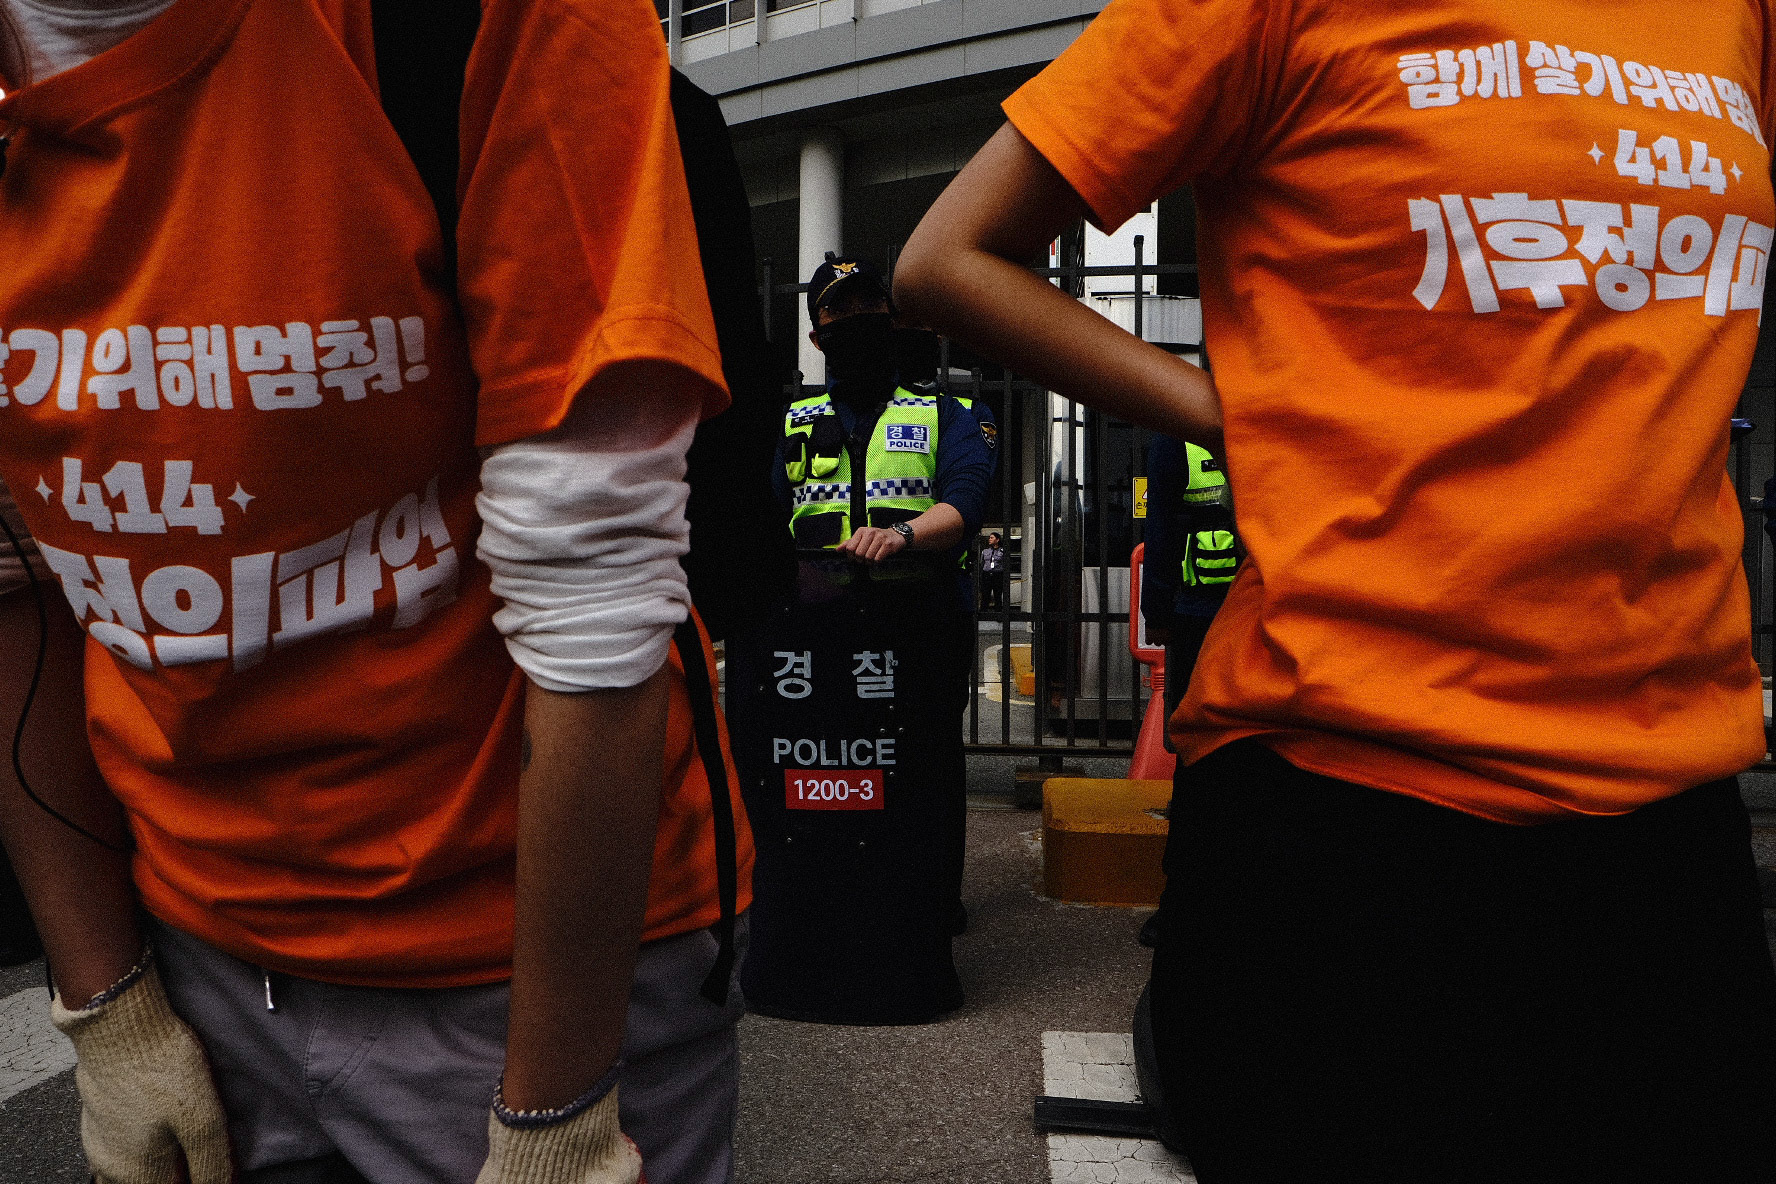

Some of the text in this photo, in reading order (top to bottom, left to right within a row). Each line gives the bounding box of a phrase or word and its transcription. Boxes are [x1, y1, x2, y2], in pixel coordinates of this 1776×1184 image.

[1397, 40, 1522, 110] 함께
[1614, 129, 1727, 195] 414
[889, 440, 925, 449] POLICE
[62, 457, 225, 535] 414
[773, 738, 897, 766] POLICE
[794, 779, 874, 801] 1200-3
